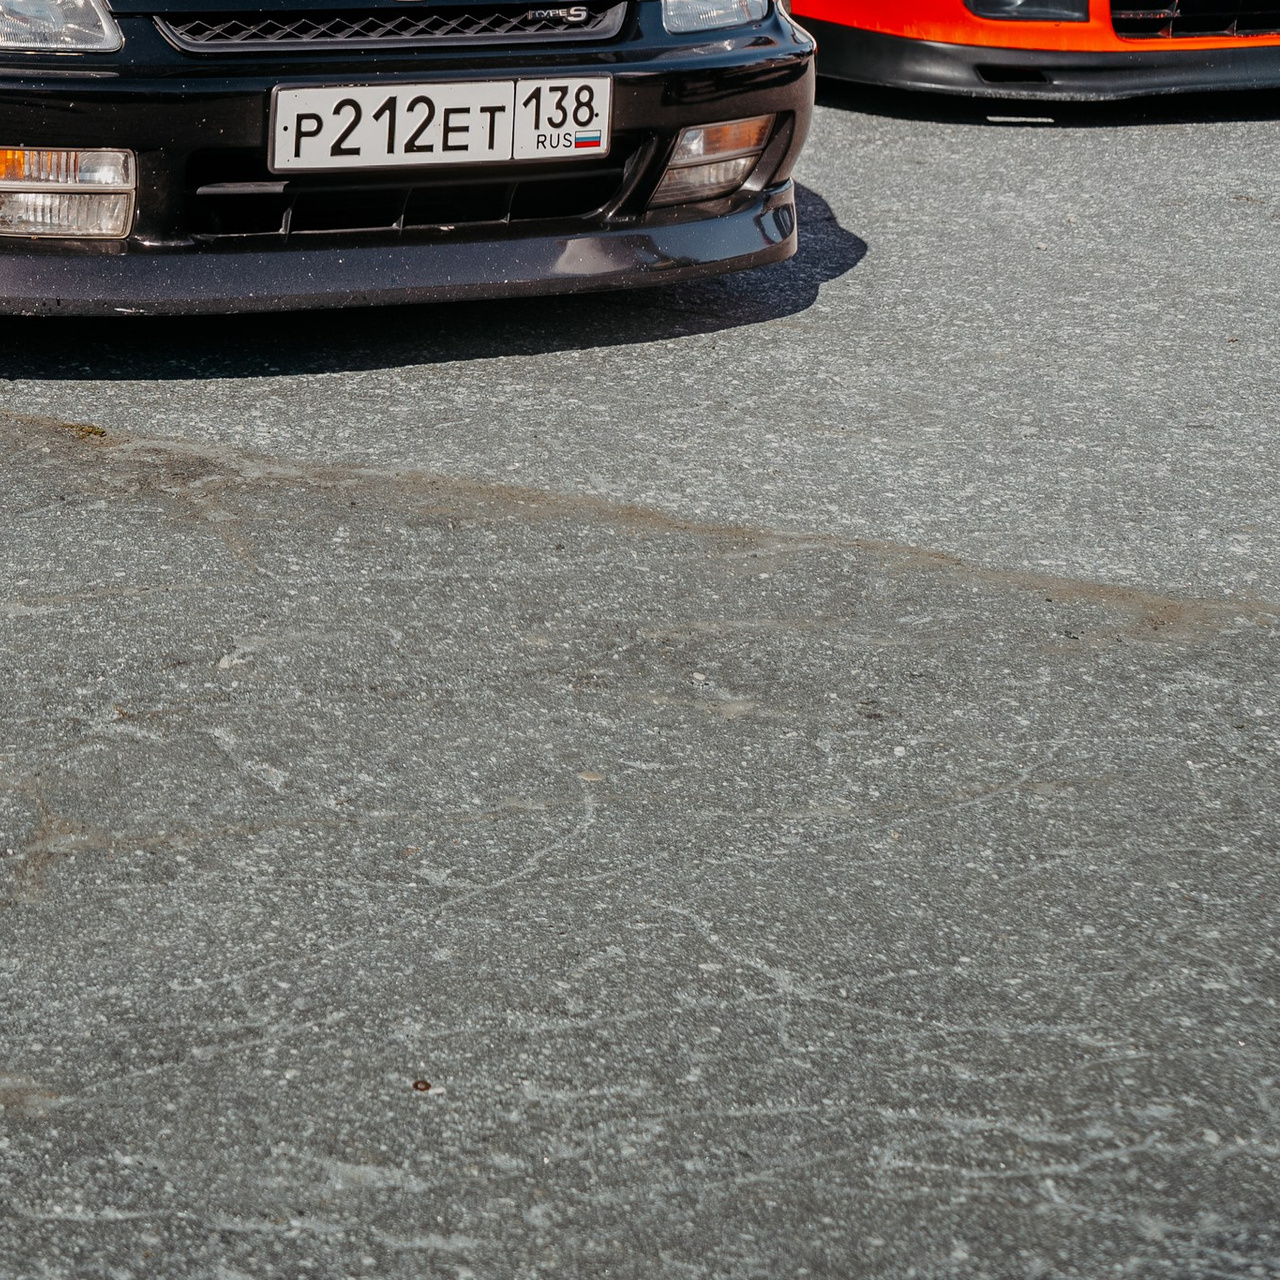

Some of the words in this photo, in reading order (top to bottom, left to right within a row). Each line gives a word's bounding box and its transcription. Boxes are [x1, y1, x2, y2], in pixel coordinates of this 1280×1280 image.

[534, 9, 568, 18] TYPE
[567, 5, 588, 22] S
[521, 84, 596, 131] 138
[535, 131, 573, 151] RUS
